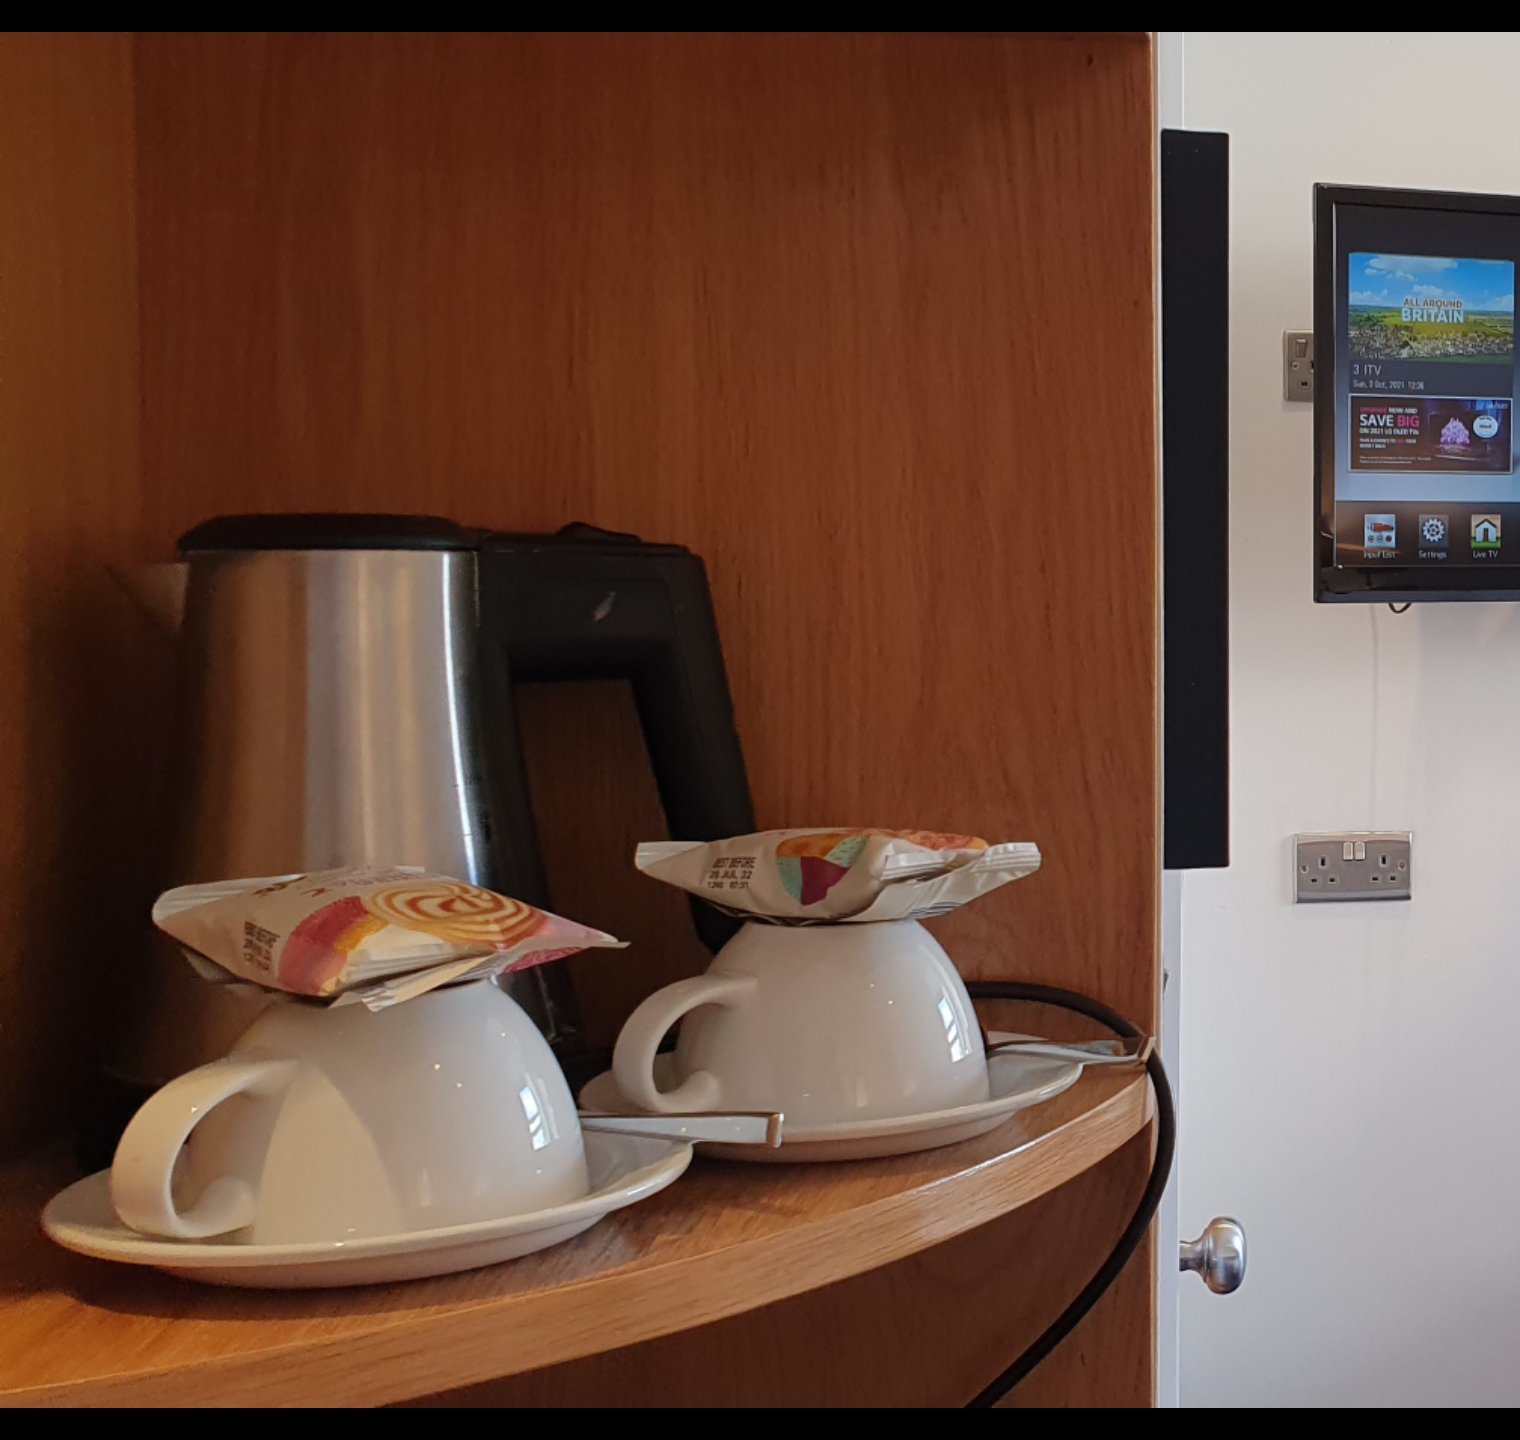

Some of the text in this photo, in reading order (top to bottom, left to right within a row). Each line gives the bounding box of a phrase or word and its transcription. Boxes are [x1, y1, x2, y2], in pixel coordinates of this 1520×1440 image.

[1403, 298, 1464, 309] ALL AROUND
[1401, 308, 1465, 323] BRITAIN
[1353, 364, 1382, 376] 3 ITV
[1389, 380, 1405, 389] 2021
[1359, 414, 1420, 427] SAVE BIG
[1419, 549, 1447, 559] Settings
[1473, 550, 1498, 558] Live TV
[721, 870, 738, 880] JUL
[740, 870, 753, 880] 22
